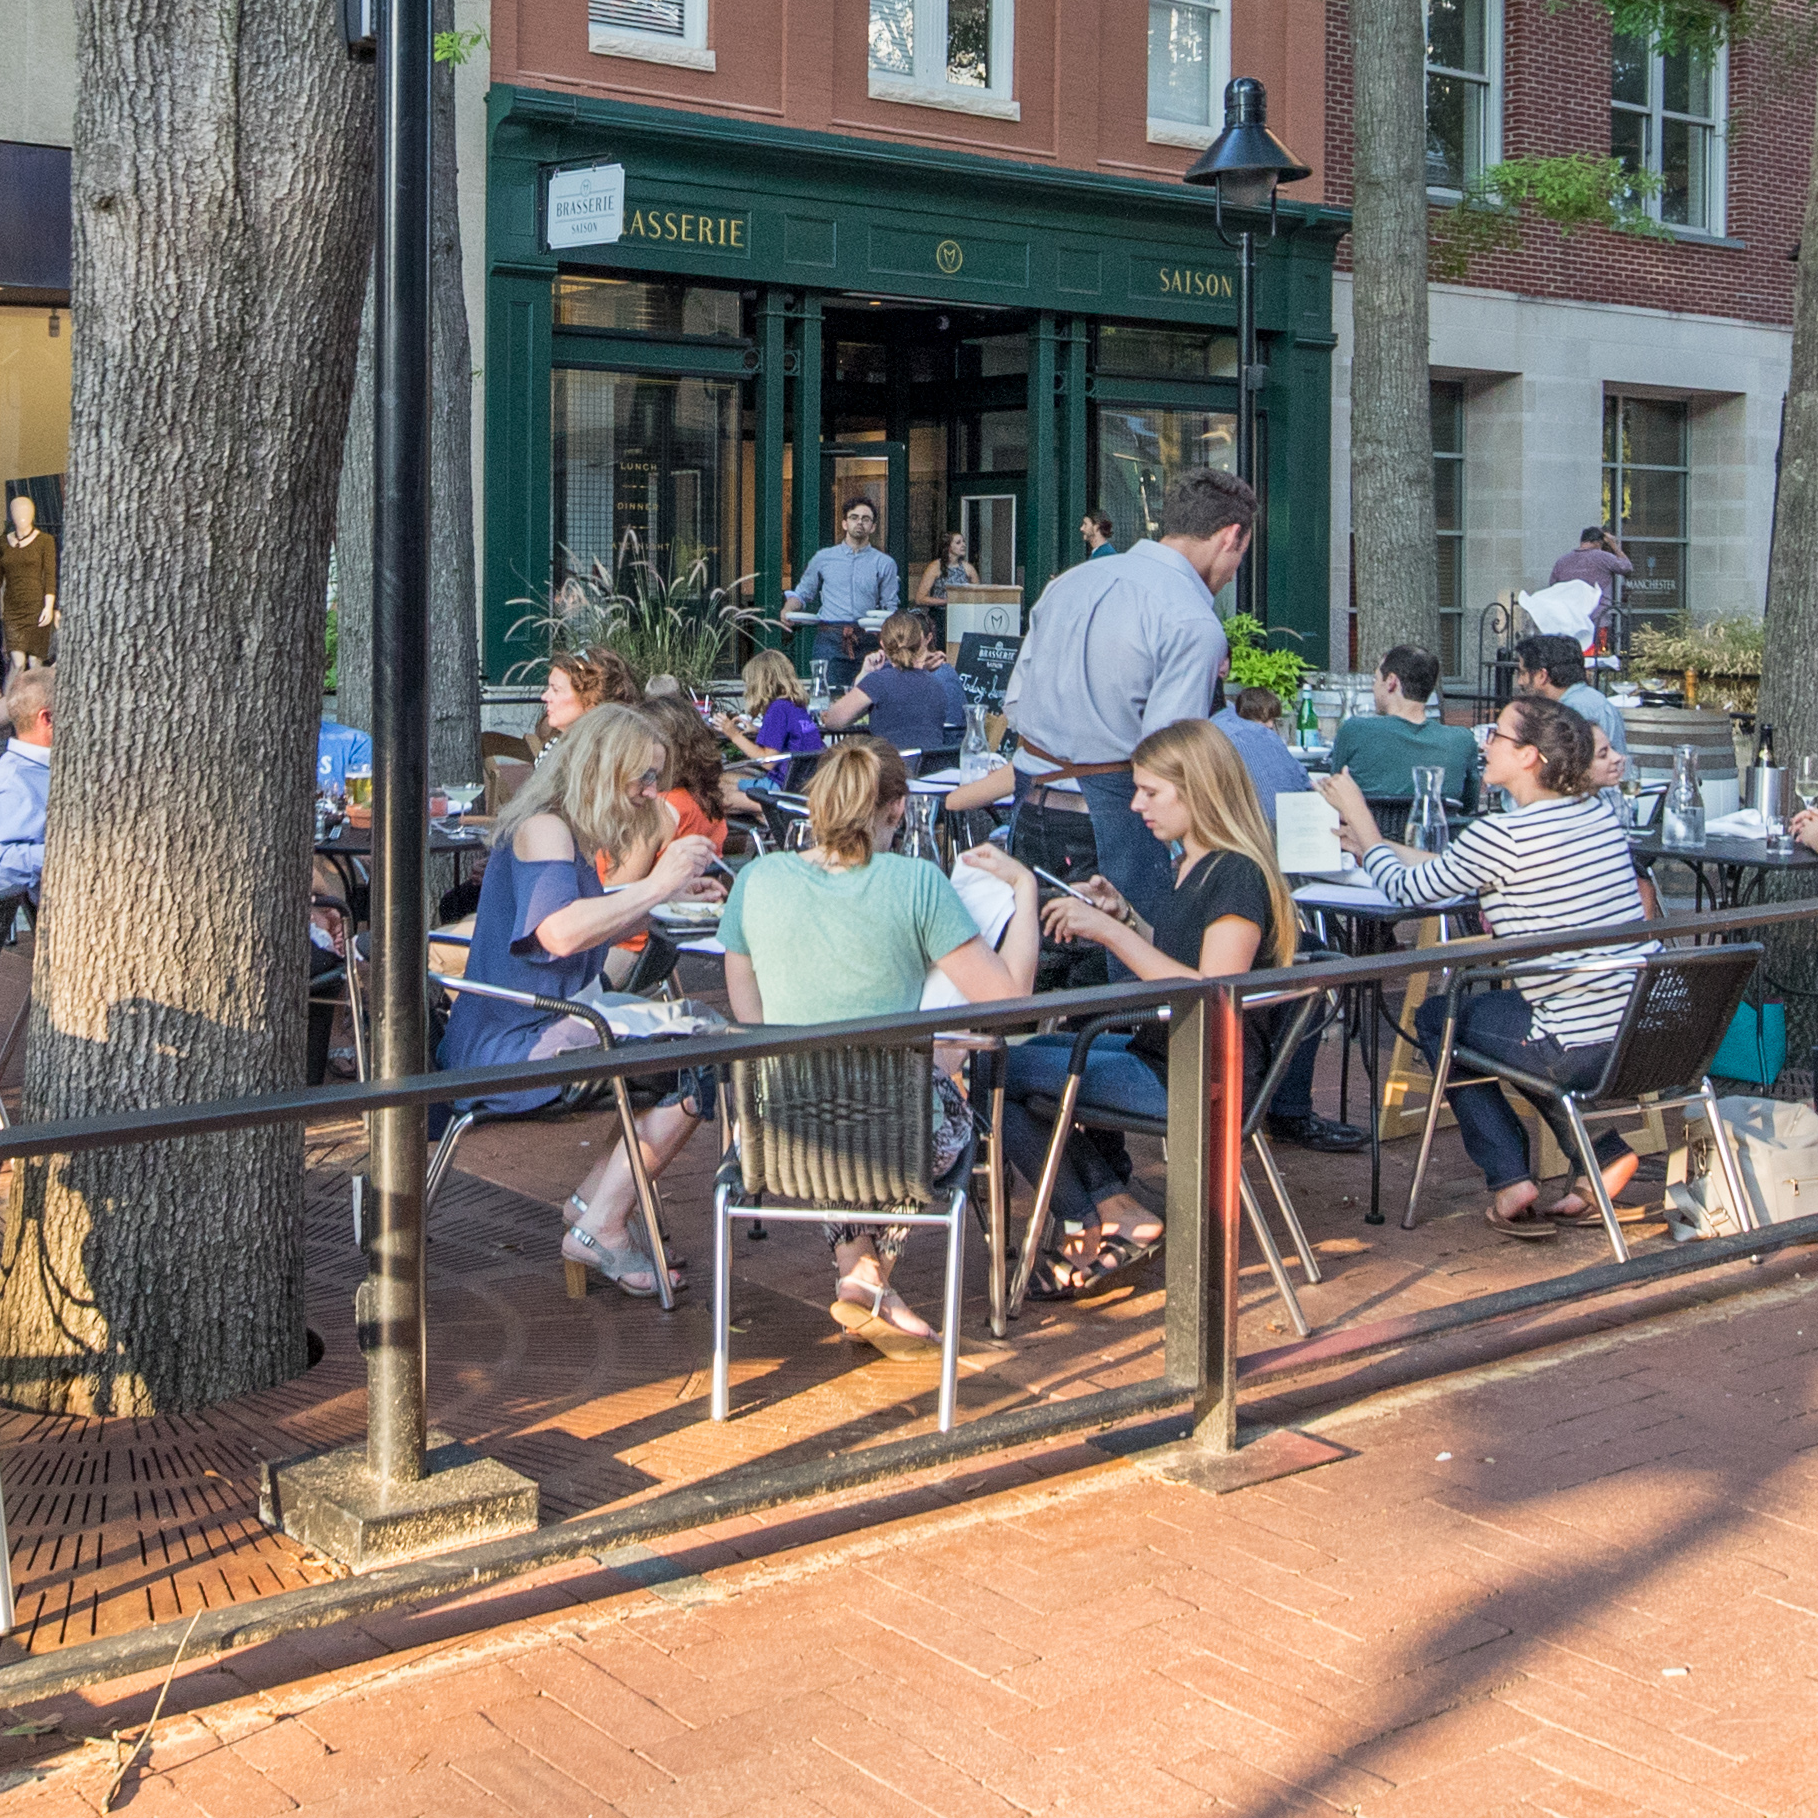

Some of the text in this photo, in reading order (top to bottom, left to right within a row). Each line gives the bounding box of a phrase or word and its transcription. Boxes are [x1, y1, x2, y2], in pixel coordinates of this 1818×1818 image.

[556, 194, 615, 218] BRASSERIE
[571, 222, 598, 235] SAISON
[623, 210, 745, 248] ASSERIE
[1159, 267, 1232, 298] SAISON
[620, 463, 657, 472] LUNCH
[617, 502, 659, 511] DINNER
[1625, 578, 1677, 590] MANCHESTER
[978, 649, 1017, 661] BRASSERIE
